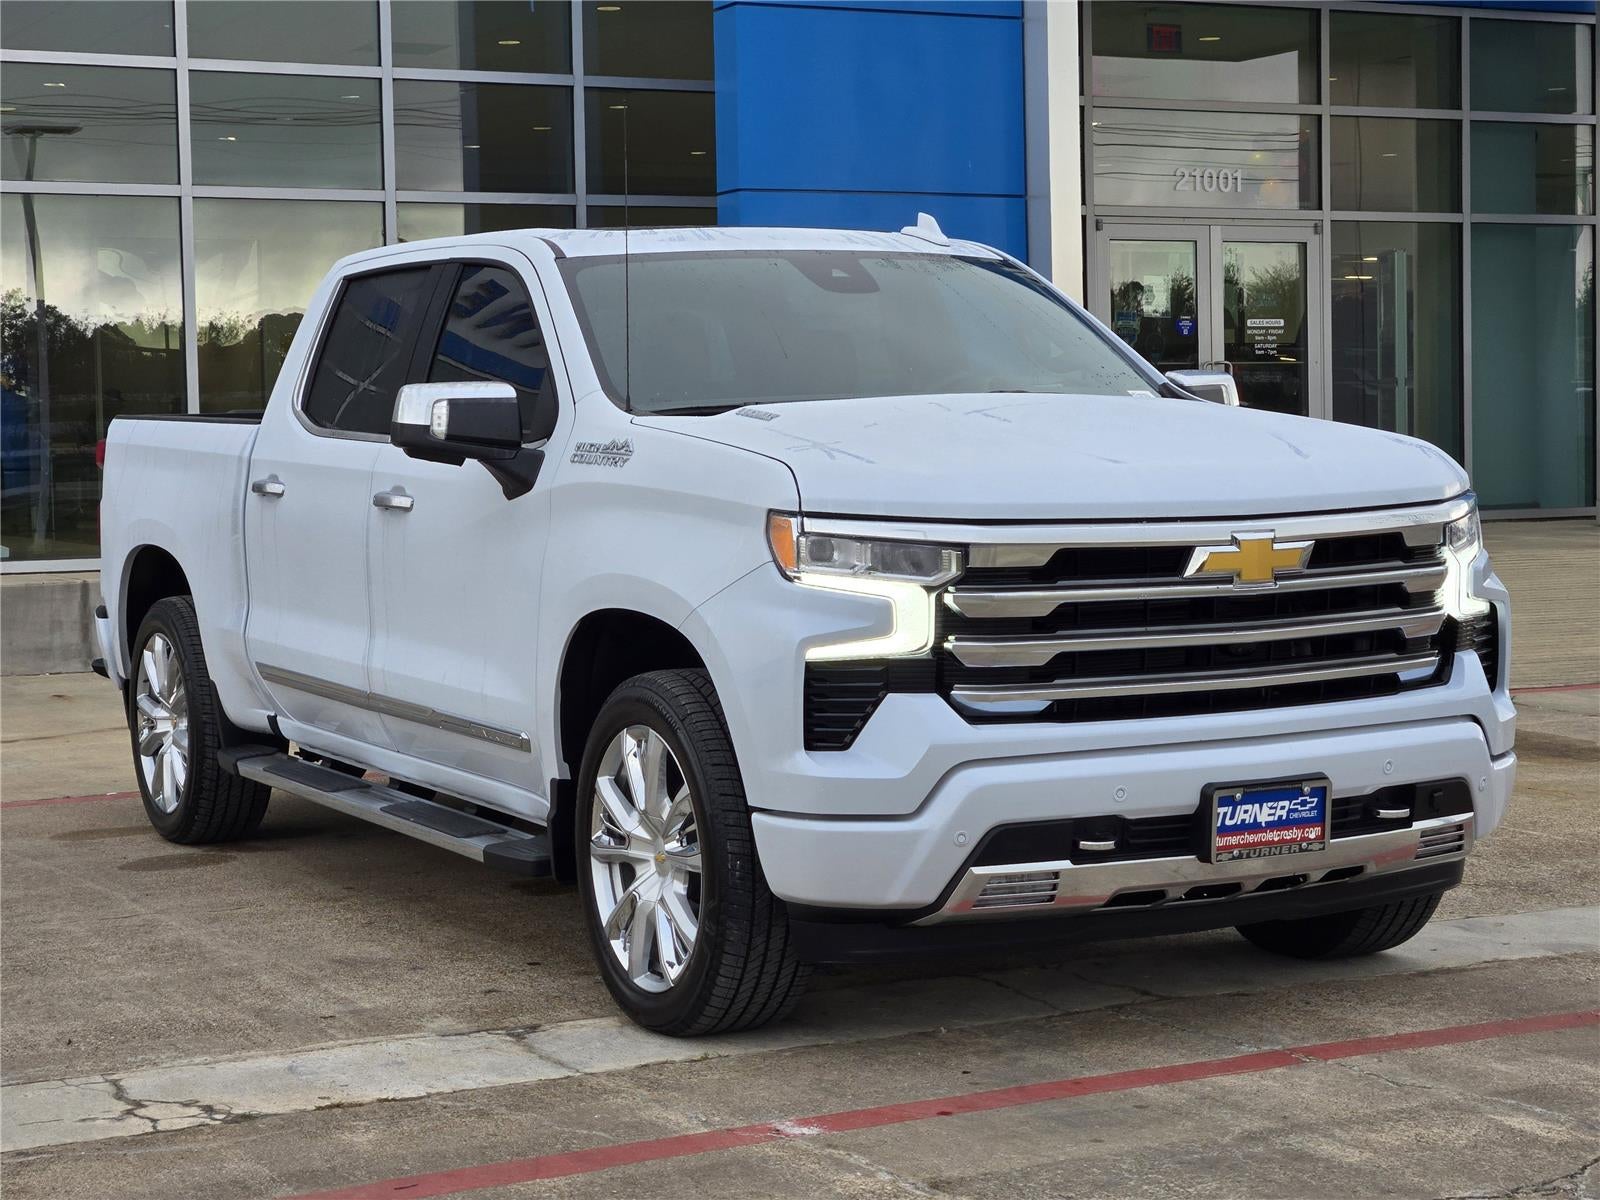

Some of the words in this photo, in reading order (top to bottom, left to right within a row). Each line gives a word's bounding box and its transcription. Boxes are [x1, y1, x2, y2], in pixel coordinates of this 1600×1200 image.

[1175, 168, 1242, 192] 21001
[570, 453, 630, 468] COUNTRY
[1216, 800, 1290, 827] TURNER
[1289, 810, 1318, 819] CHEVROLET
[1216, 826, 1321, 846] turnerchevroletcrosby.com
[1241, 845, 1300, 859] TURNER
